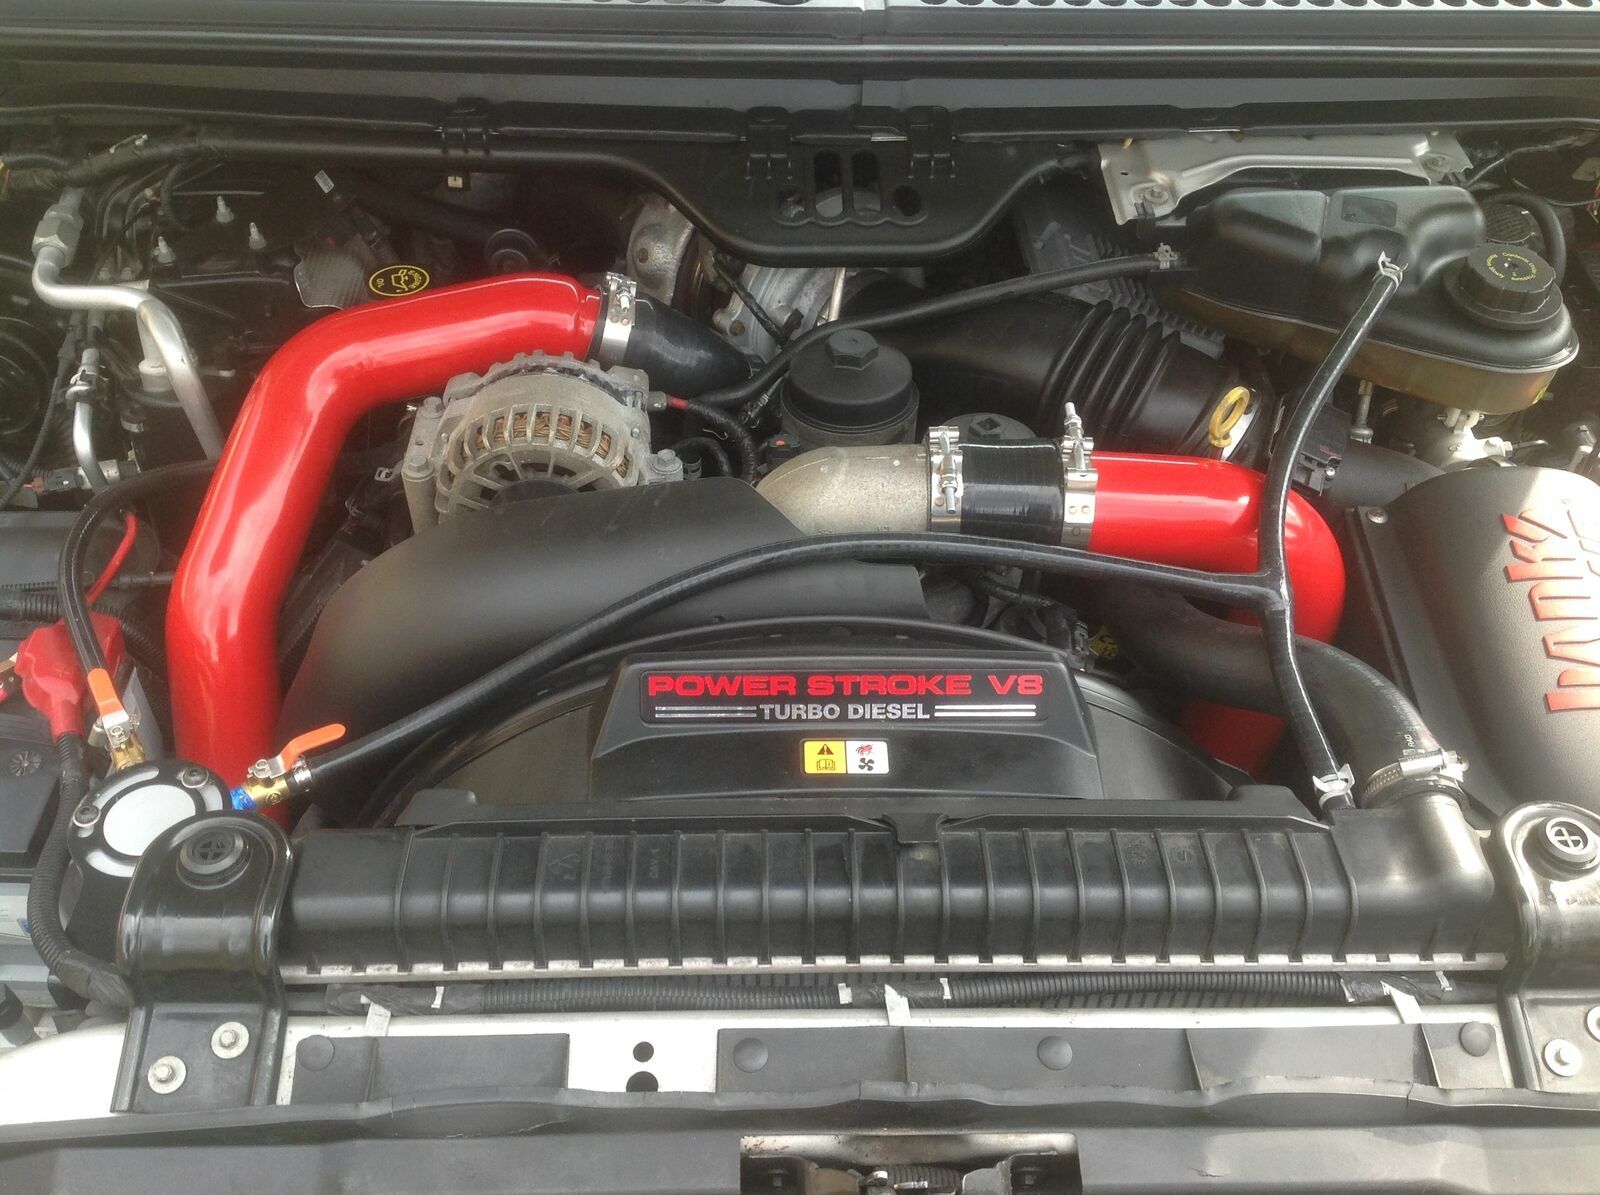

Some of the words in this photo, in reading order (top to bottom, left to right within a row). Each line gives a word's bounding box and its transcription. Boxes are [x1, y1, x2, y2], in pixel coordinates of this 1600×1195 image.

[648, 675, 797, 697] POWER
[807, 674, 972, 696] STROKE
[987, 674, 1043, 695] V8
[759, 703, 841, 720] TURBO
[847, 703, 931, 719] DIESEL
